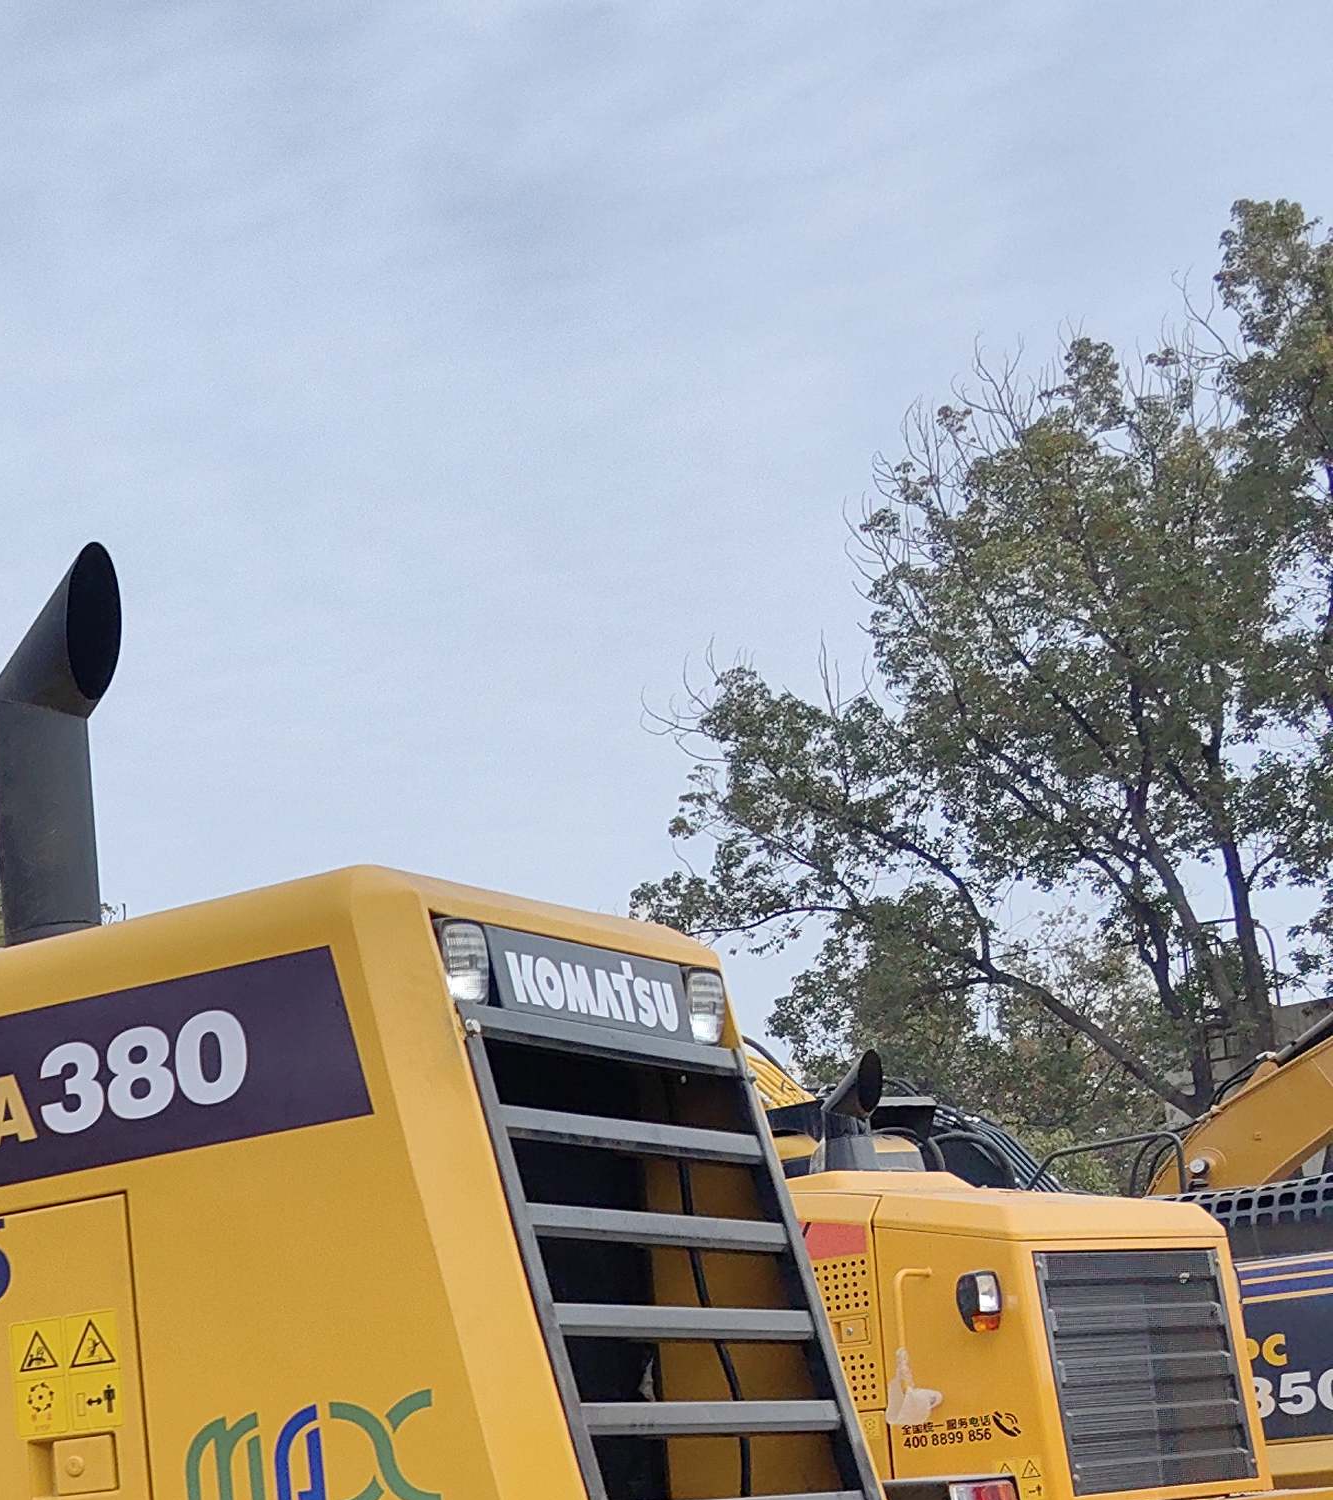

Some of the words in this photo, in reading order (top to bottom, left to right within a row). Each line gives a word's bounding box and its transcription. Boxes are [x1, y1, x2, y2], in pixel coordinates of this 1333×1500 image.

[504, 951, 680, 1032] KOMATSU
[903, 1434, 929, 1449] 400
[931, 1430, 964, 1446] 8899
[968, 1427, 993, 1442] 856
